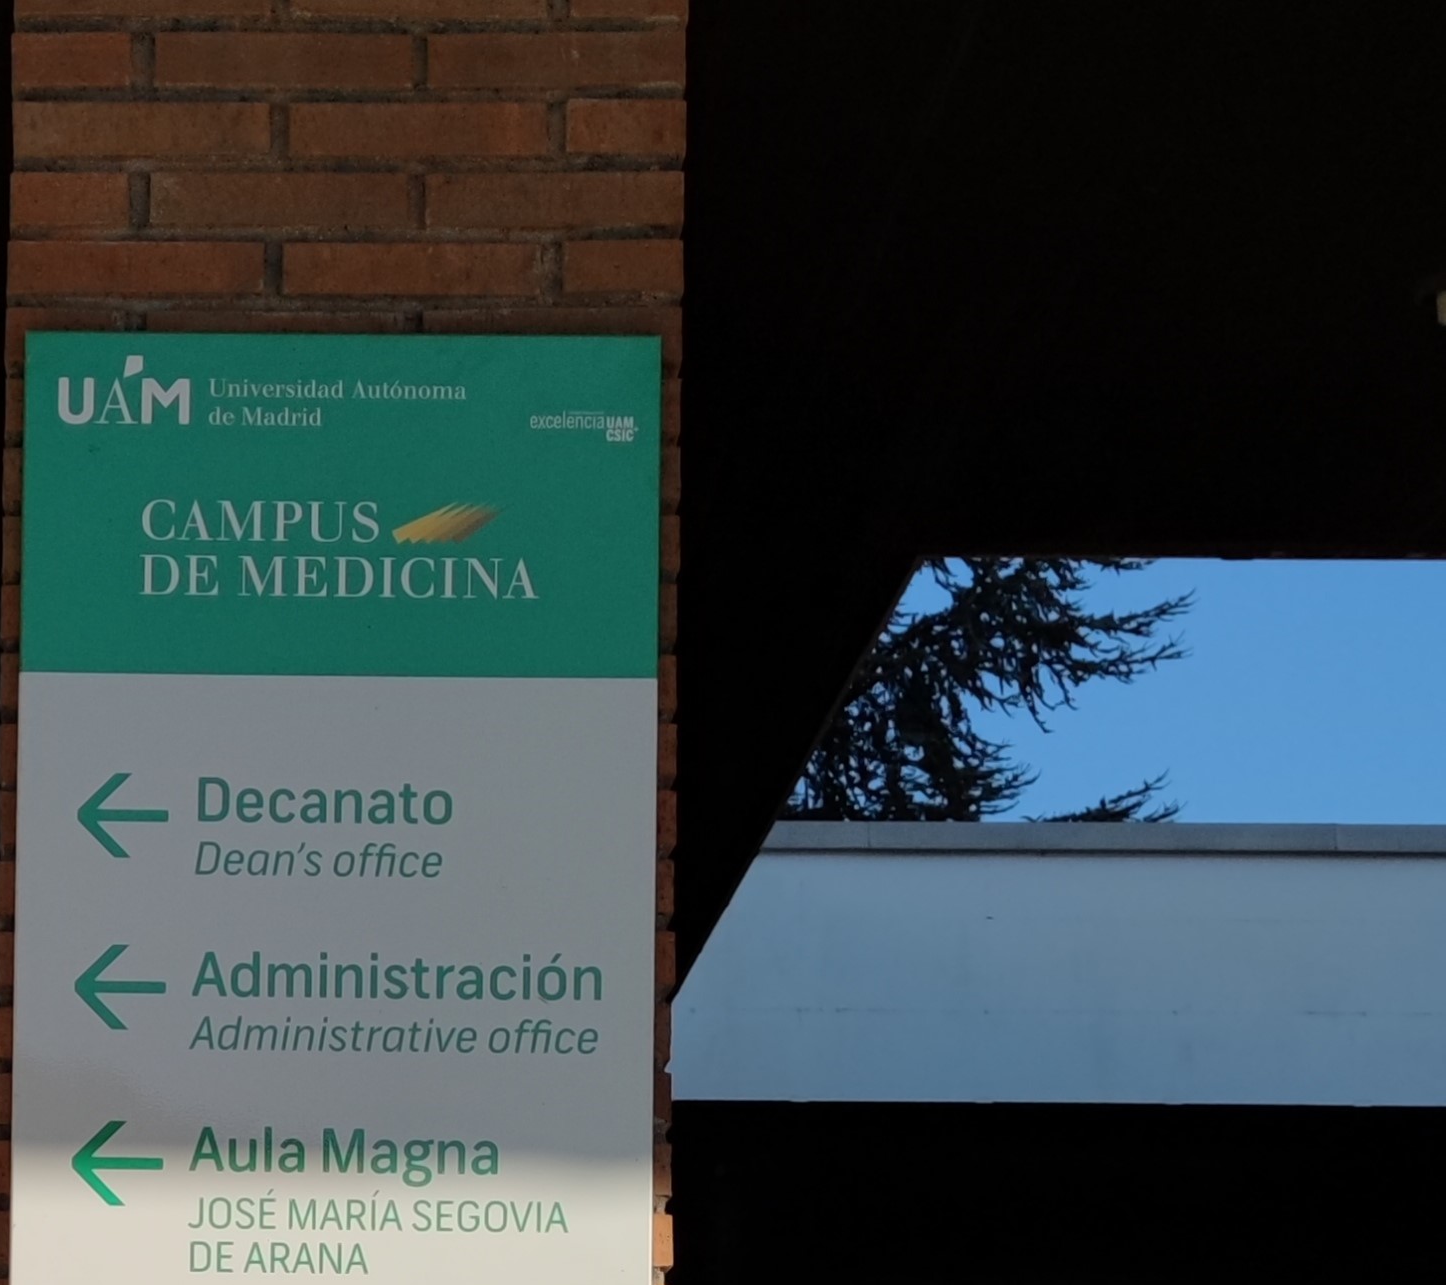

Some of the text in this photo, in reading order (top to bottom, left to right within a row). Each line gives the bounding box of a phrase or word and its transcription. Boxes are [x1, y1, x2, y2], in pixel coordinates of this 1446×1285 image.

[208, 377, 467, 401] Universidad Autónoma
[208, 407, 322, 427] de Madrid
[530, 411, 604, 429] excelencia
[605, 429, 634, 442] CSIC
[141, 500, 380, 542] CAMPUS
[139, 555, 540, 600] DE MEDICINA
[196, 777, 454, 825] Decanato
[194, 841, 444, 878] Dean's office
[192, 951, 604, 1002] Administración
[189, 1016, 600, 1055] Administrative office
[188, 1126, 500, 1188] Aula Magna
[187, 1189, 569, 1234] JOSÉ MARÍA SEGOVIA
[189, 1241, 369, 1275] DE ARANA
